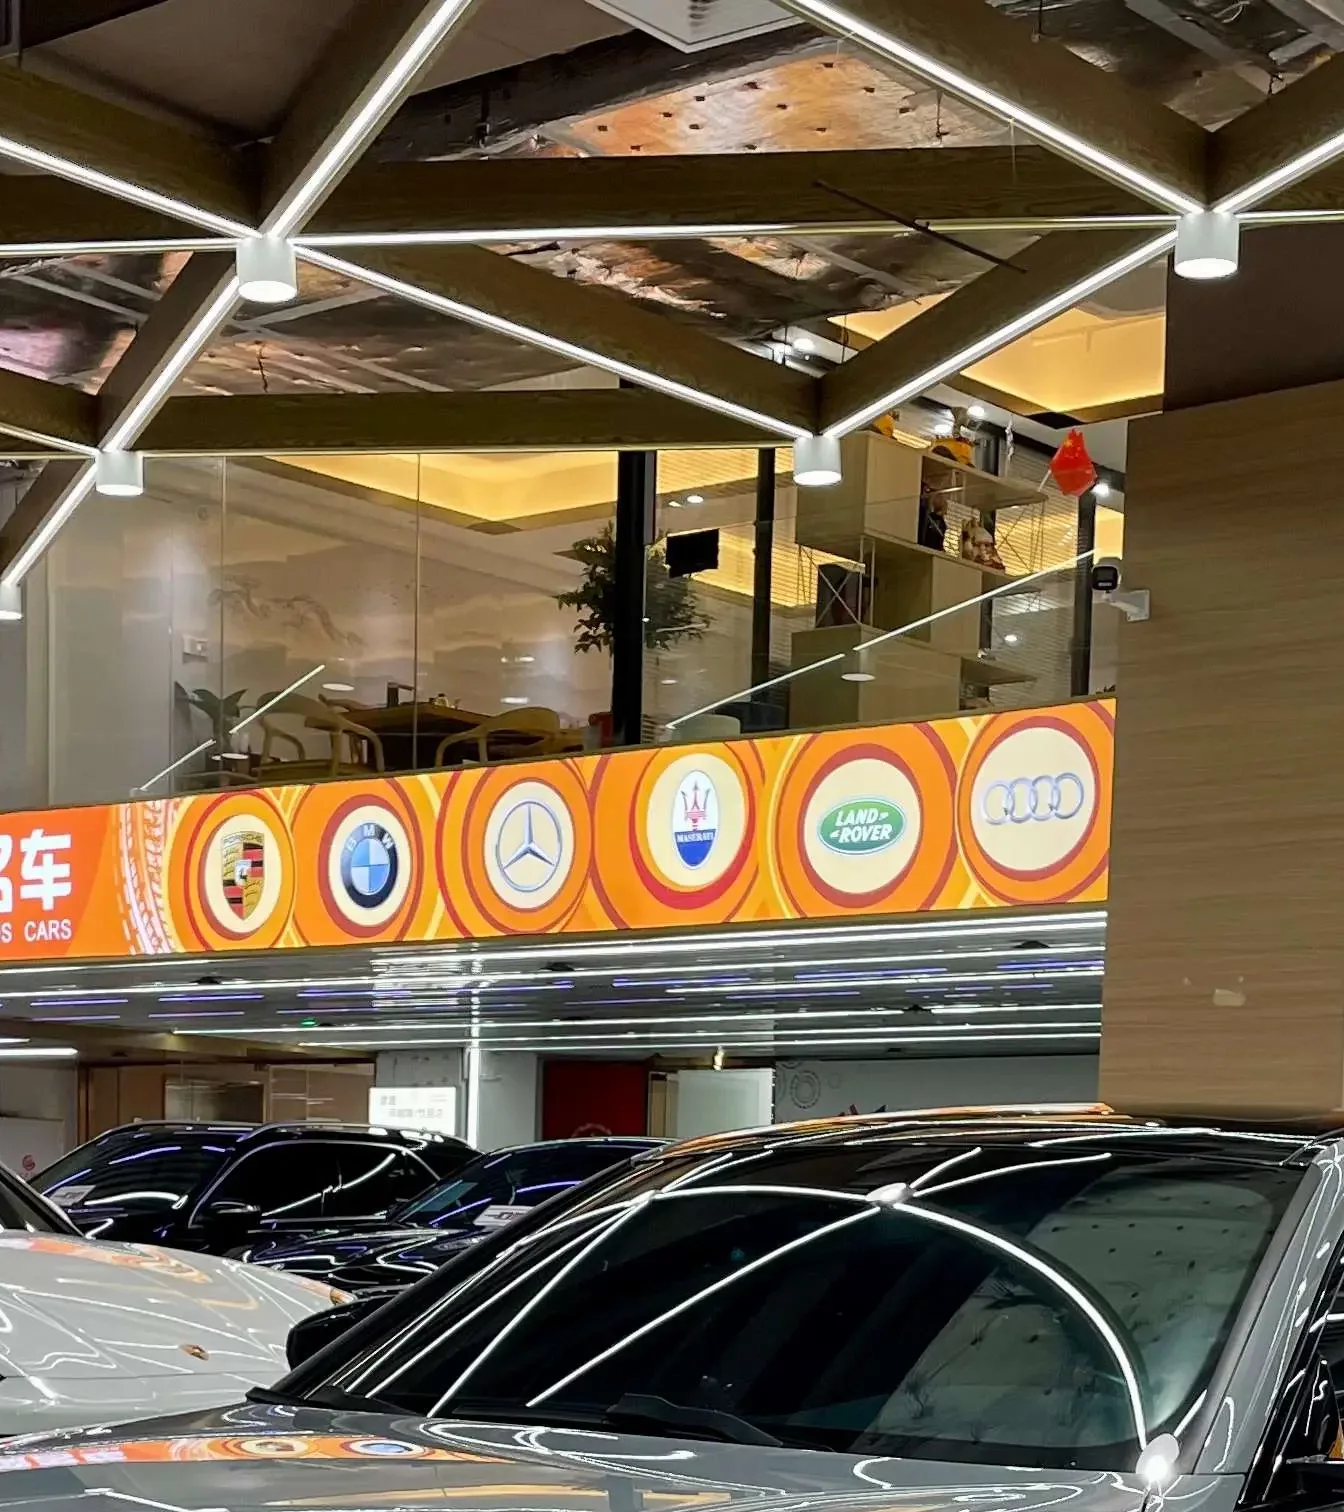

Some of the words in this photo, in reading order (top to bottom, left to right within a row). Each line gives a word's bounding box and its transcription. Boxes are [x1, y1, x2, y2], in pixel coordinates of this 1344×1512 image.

[835, 808, 879, 826] LAND
[346, 823, 394, 851] BMW
[838, 823, 892, 843] ROVER
[23, 918, 72, 941] CARS
